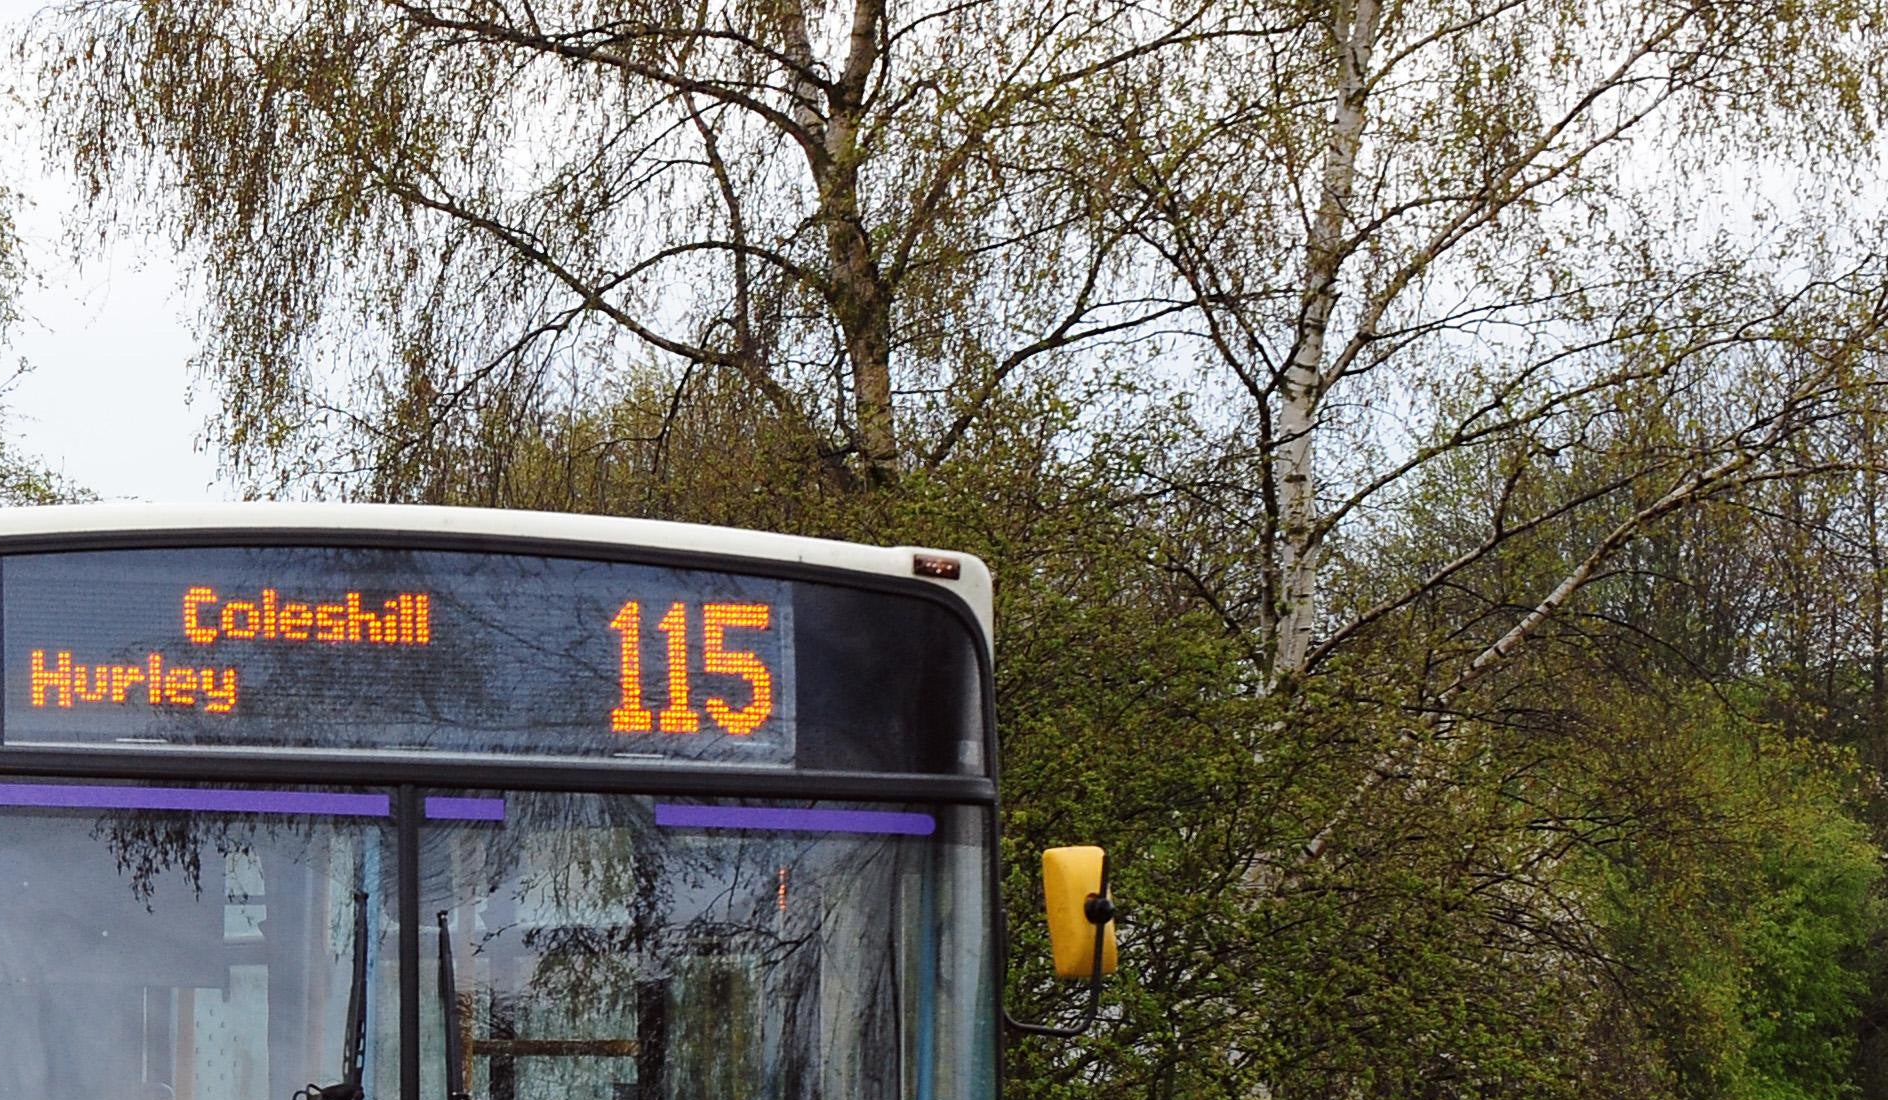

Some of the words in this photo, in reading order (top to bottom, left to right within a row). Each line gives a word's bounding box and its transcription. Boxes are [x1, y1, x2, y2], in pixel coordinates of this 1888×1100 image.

[182, 586, 430, 644] Coleshill
[31, 649, 237, 713] Hurley
[609, 600, 773, 735] 115
